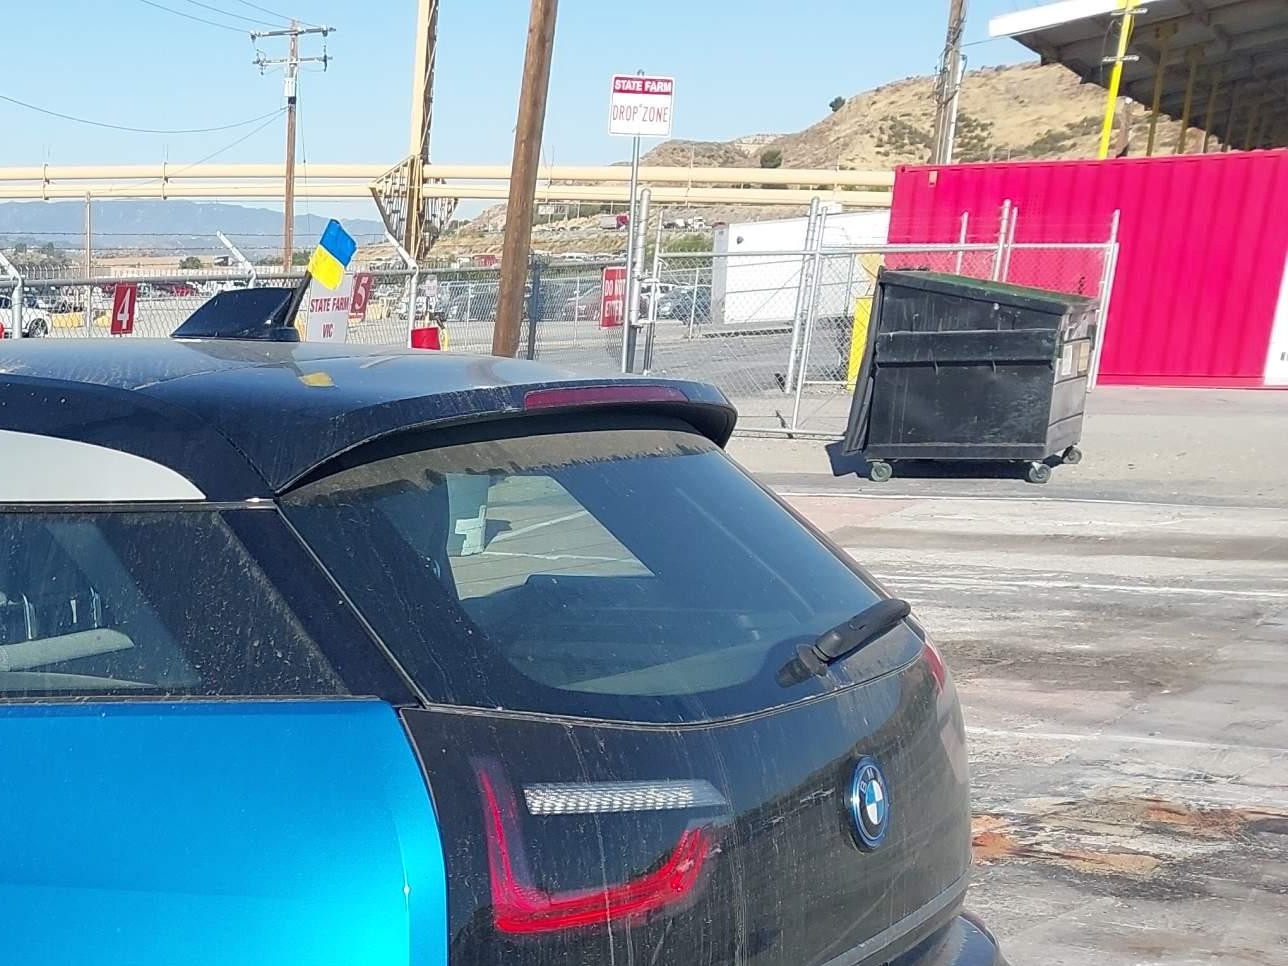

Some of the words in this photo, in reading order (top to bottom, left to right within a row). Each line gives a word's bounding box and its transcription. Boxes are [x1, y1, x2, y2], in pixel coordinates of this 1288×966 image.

[614, 80, 643, 91] STATE
[644, 81, 672, 93] FARM
[612, 104, 639, 121] DROP
[642, 106, 668, 123] ZONE
[354, 276, 369, 310] 5
[604, 279, 614, 297] DO
[117, 287, 131, 330] 4
[310, 298, 330, 312] STATE
[332, 296, 349, 312] FARM
